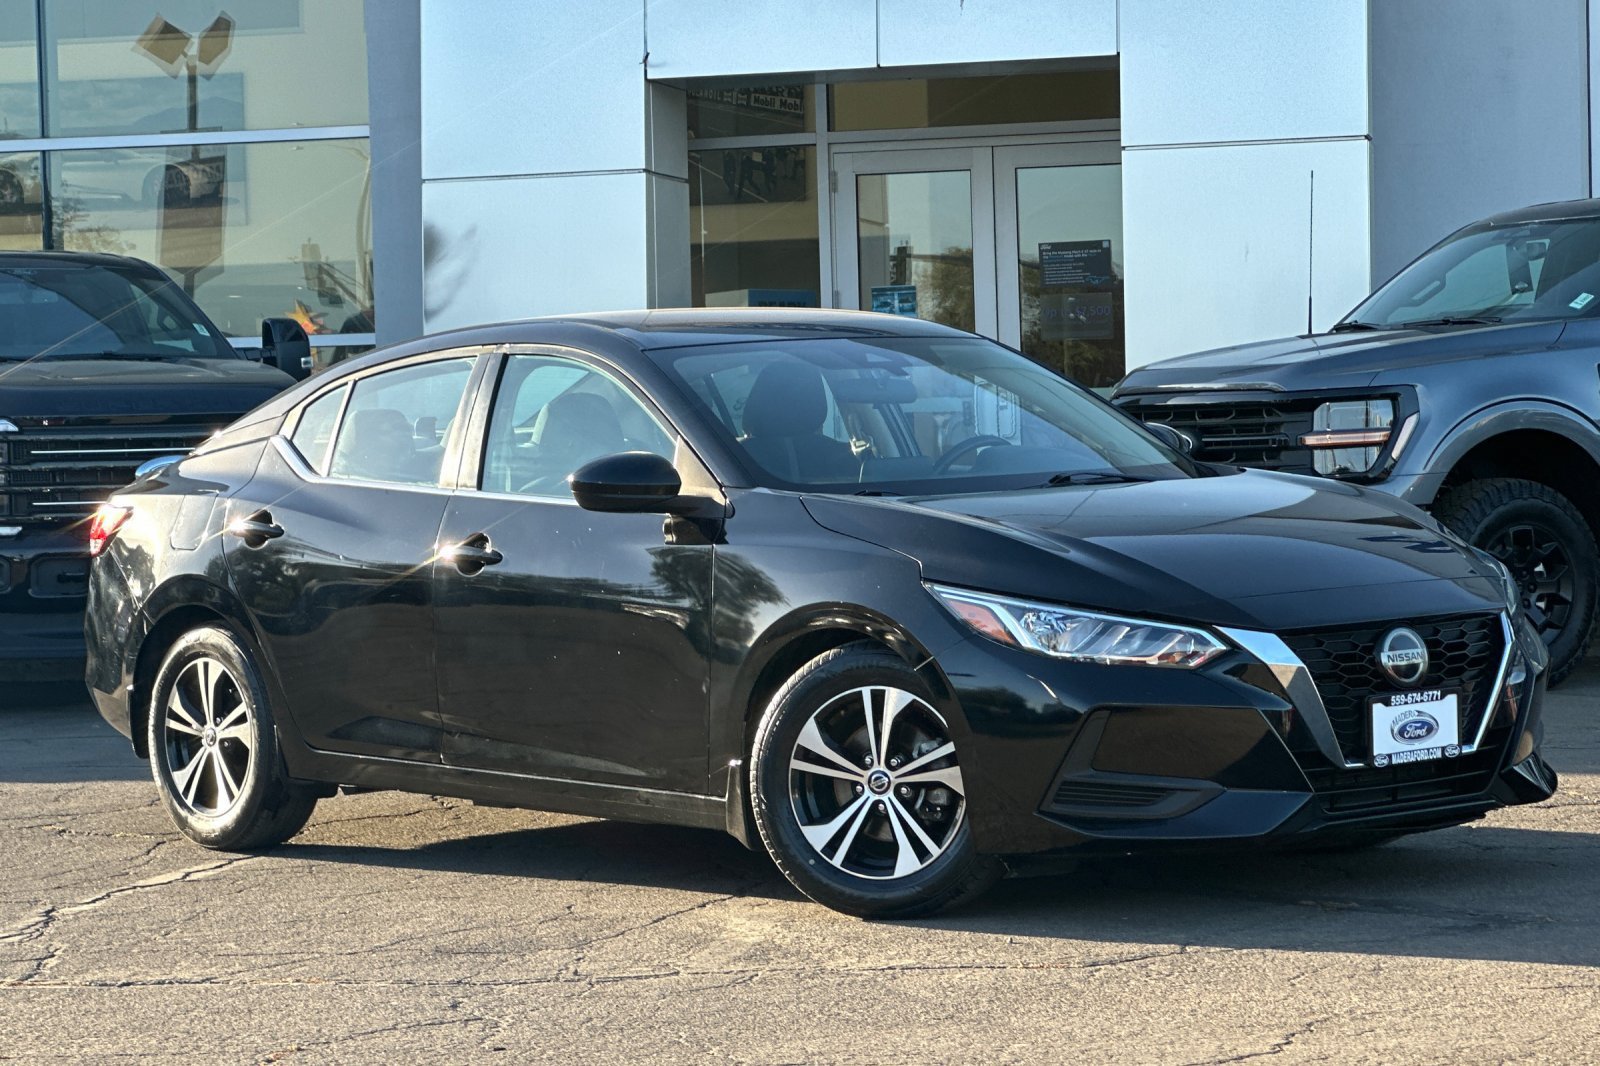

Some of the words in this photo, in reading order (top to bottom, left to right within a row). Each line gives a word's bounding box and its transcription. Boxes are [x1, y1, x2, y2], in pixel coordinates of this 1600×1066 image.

[753, 96, 776, 108] Mobil
[1387, 651, 1424, 663] NISSAN
[1390, 690, 1441, 706] 559-674-6771
[1391, 709, 1416, 728] MADERA
[1404, 723, 1428, 738] Ford
[1391, 748, 1442, 765] MADERAFORD.COM
